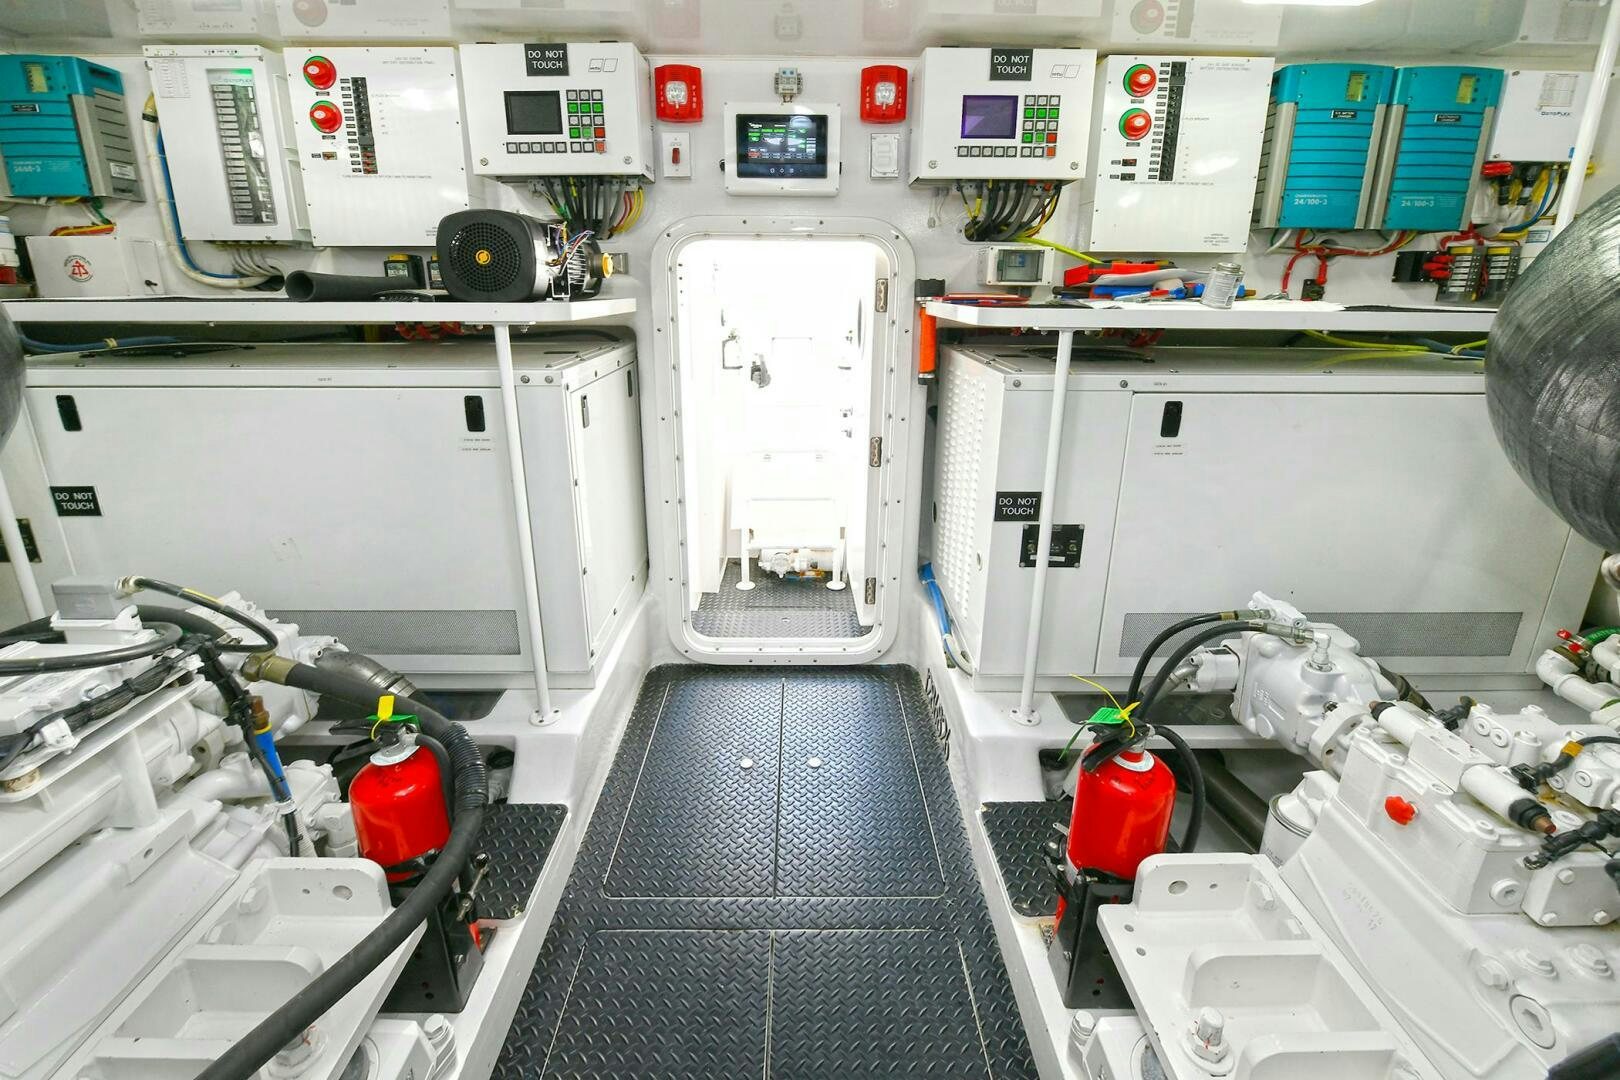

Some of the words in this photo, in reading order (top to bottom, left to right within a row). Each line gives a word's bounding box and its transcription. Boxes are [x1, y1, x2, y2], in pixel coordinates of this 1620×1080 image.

[528, 50, 541, 59] DO
[545, 50, 564, 59] NOT
[994, 55, 1007, 63] DO
[1011, 55, 1030, 63] NOT
[532, 60, 563, 69] TOUCH
[997, 65, 1027, 74] TOUCH
[55, 492, 69, 500] DO
[74, 492, 93, 500] NOT
[61, 502, 94, 510] TOUCH
[1002, 507, 1034, 515] TOUCH
